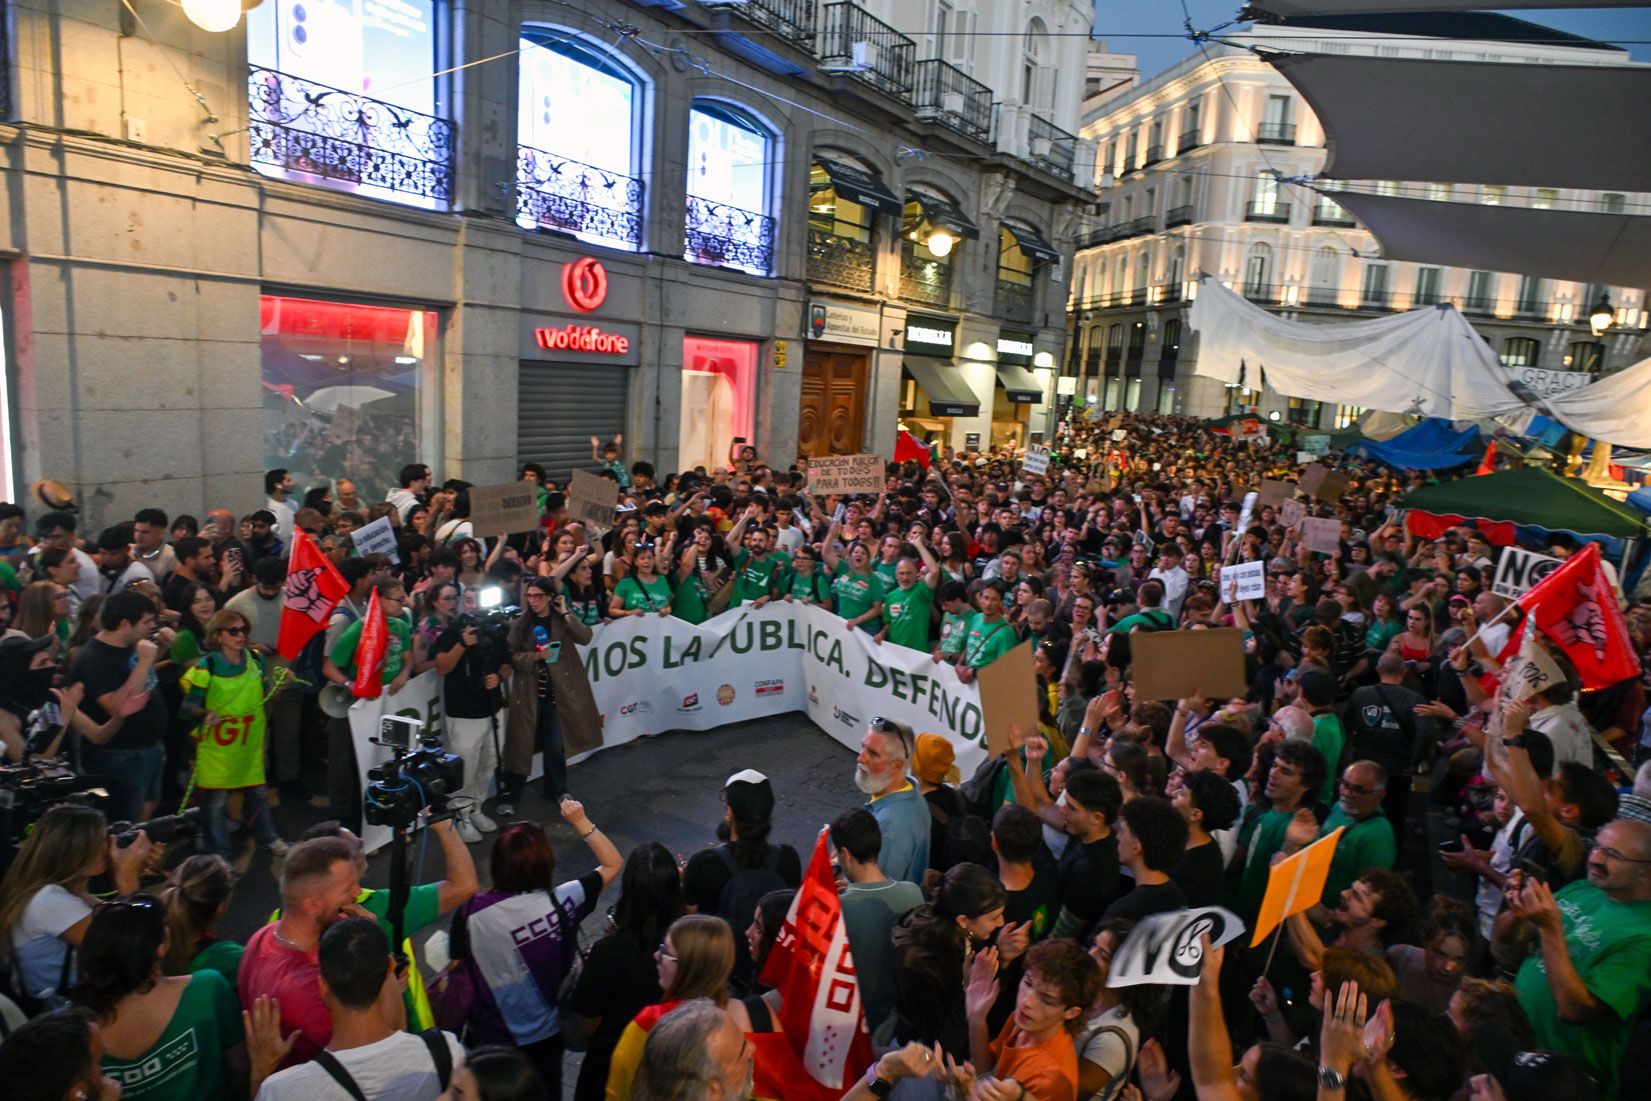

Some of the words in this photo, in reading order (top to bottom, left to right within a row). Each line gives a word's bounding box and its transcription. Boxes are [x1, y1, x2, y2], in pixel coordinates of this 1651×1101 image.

[535, 324, 629, 353] vodafone
[815, 478, 839, 489] PARA
[662, 635, 702, 669] LA
[711, 612, 852, 679] ÚBLICA.
[863, 655, 989, 751] DEFEND
